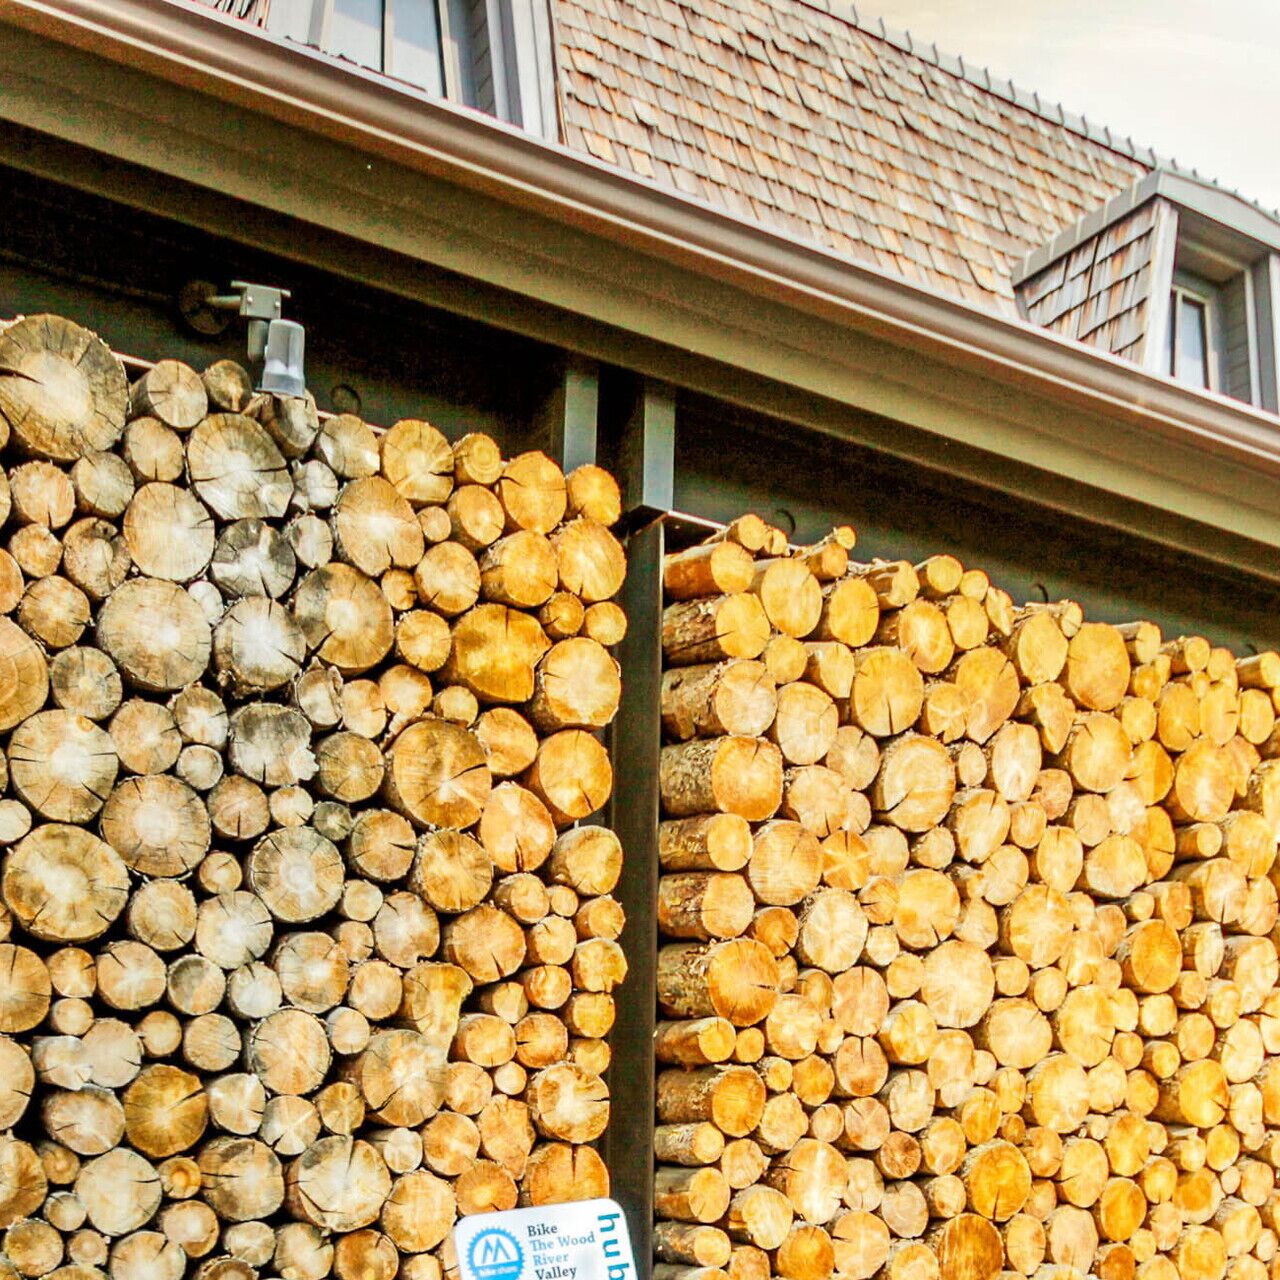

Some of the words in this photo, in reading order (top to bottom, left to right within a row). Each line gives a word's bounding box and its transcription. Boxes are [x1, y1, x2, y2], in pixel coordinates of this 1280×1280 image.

[527, 1223, 558, 1237] Bike
[529, 1239, 554, 1252] The
[557, 1231, 596, 1247] Wood
[532, 1252, 569, 1266] River
[535, 1266, 577, 1280] Valley
